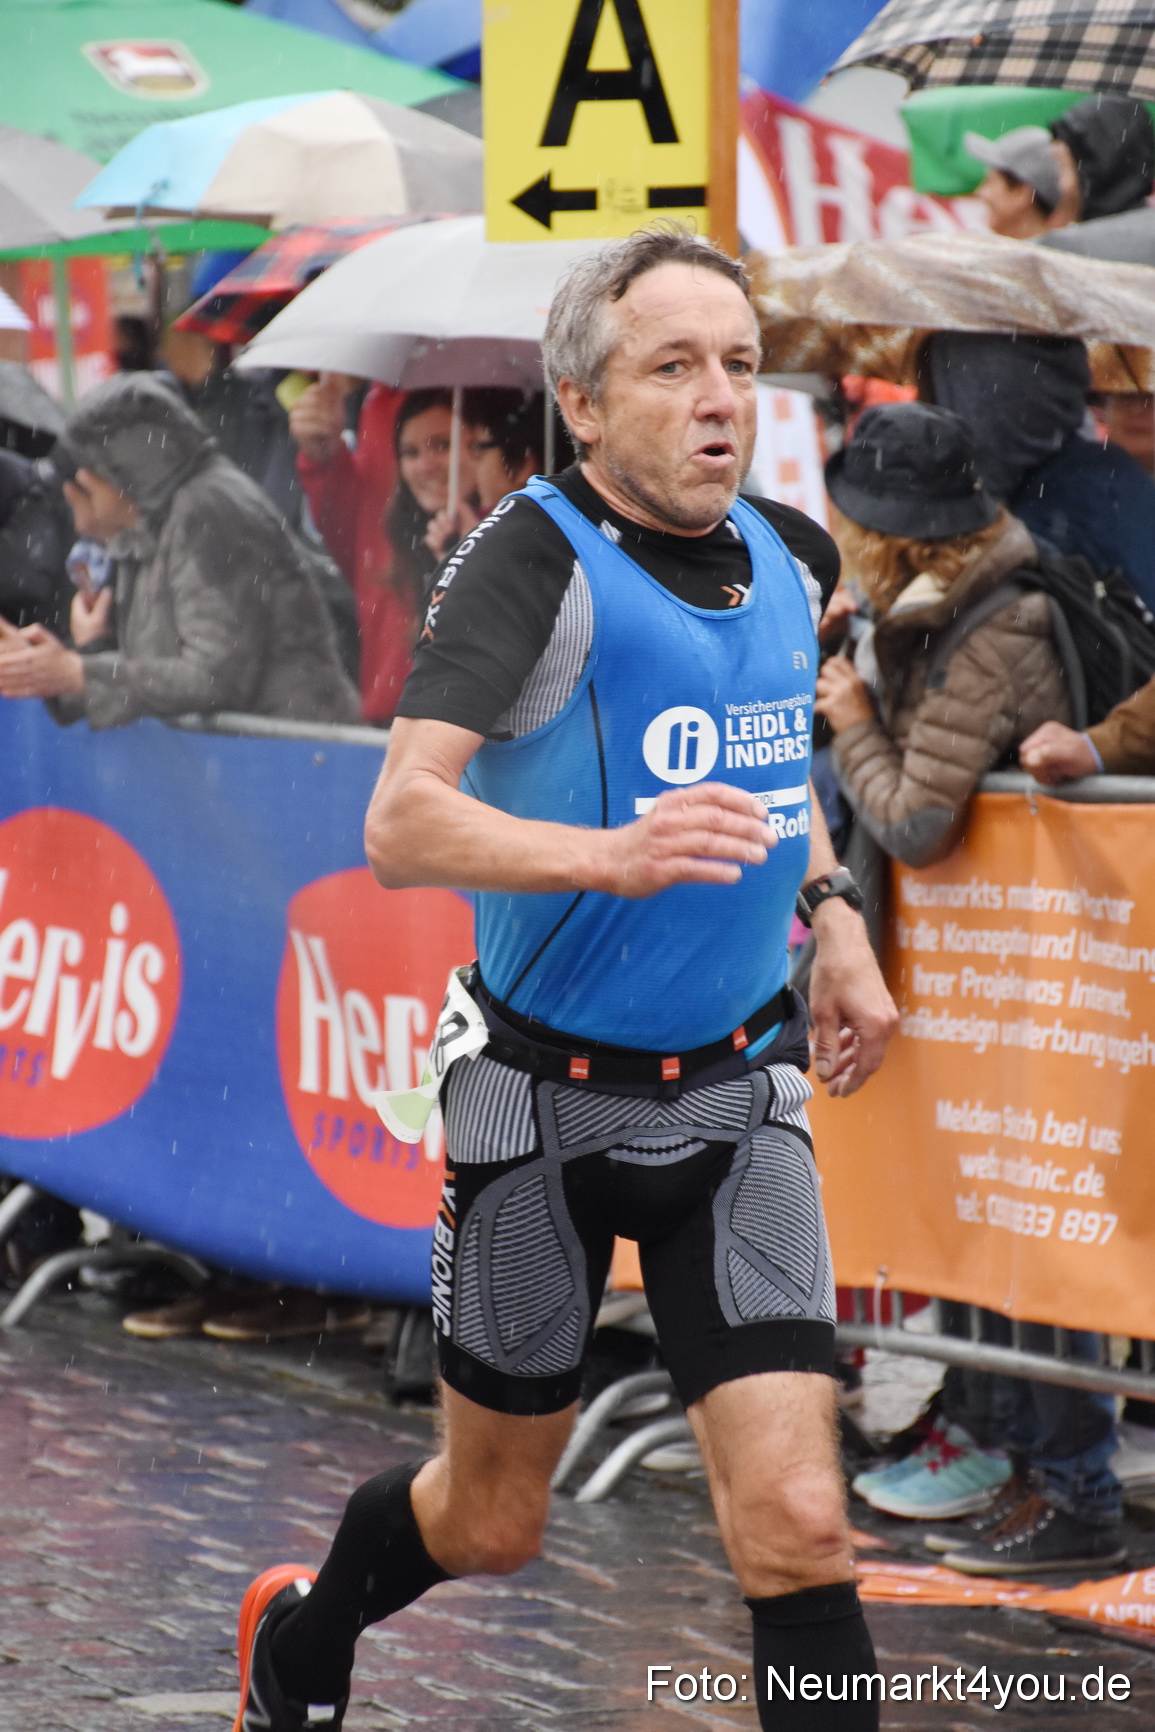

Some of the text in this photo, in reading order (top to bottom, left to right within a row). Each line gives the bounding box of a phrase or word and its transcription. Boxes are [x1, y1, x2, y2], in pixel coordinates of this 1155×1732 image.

[537, 0, 680, 147] A
[777, 112, 990, 244] He
[725, 707, 807, 742] LEIDL &
[1030, 927, 1076, 961] und
[0, 867, 165, 1081] ervis
[1041, 1110, 1088, 1148] bei
[1058, 1208, 1118, 1245] 897
